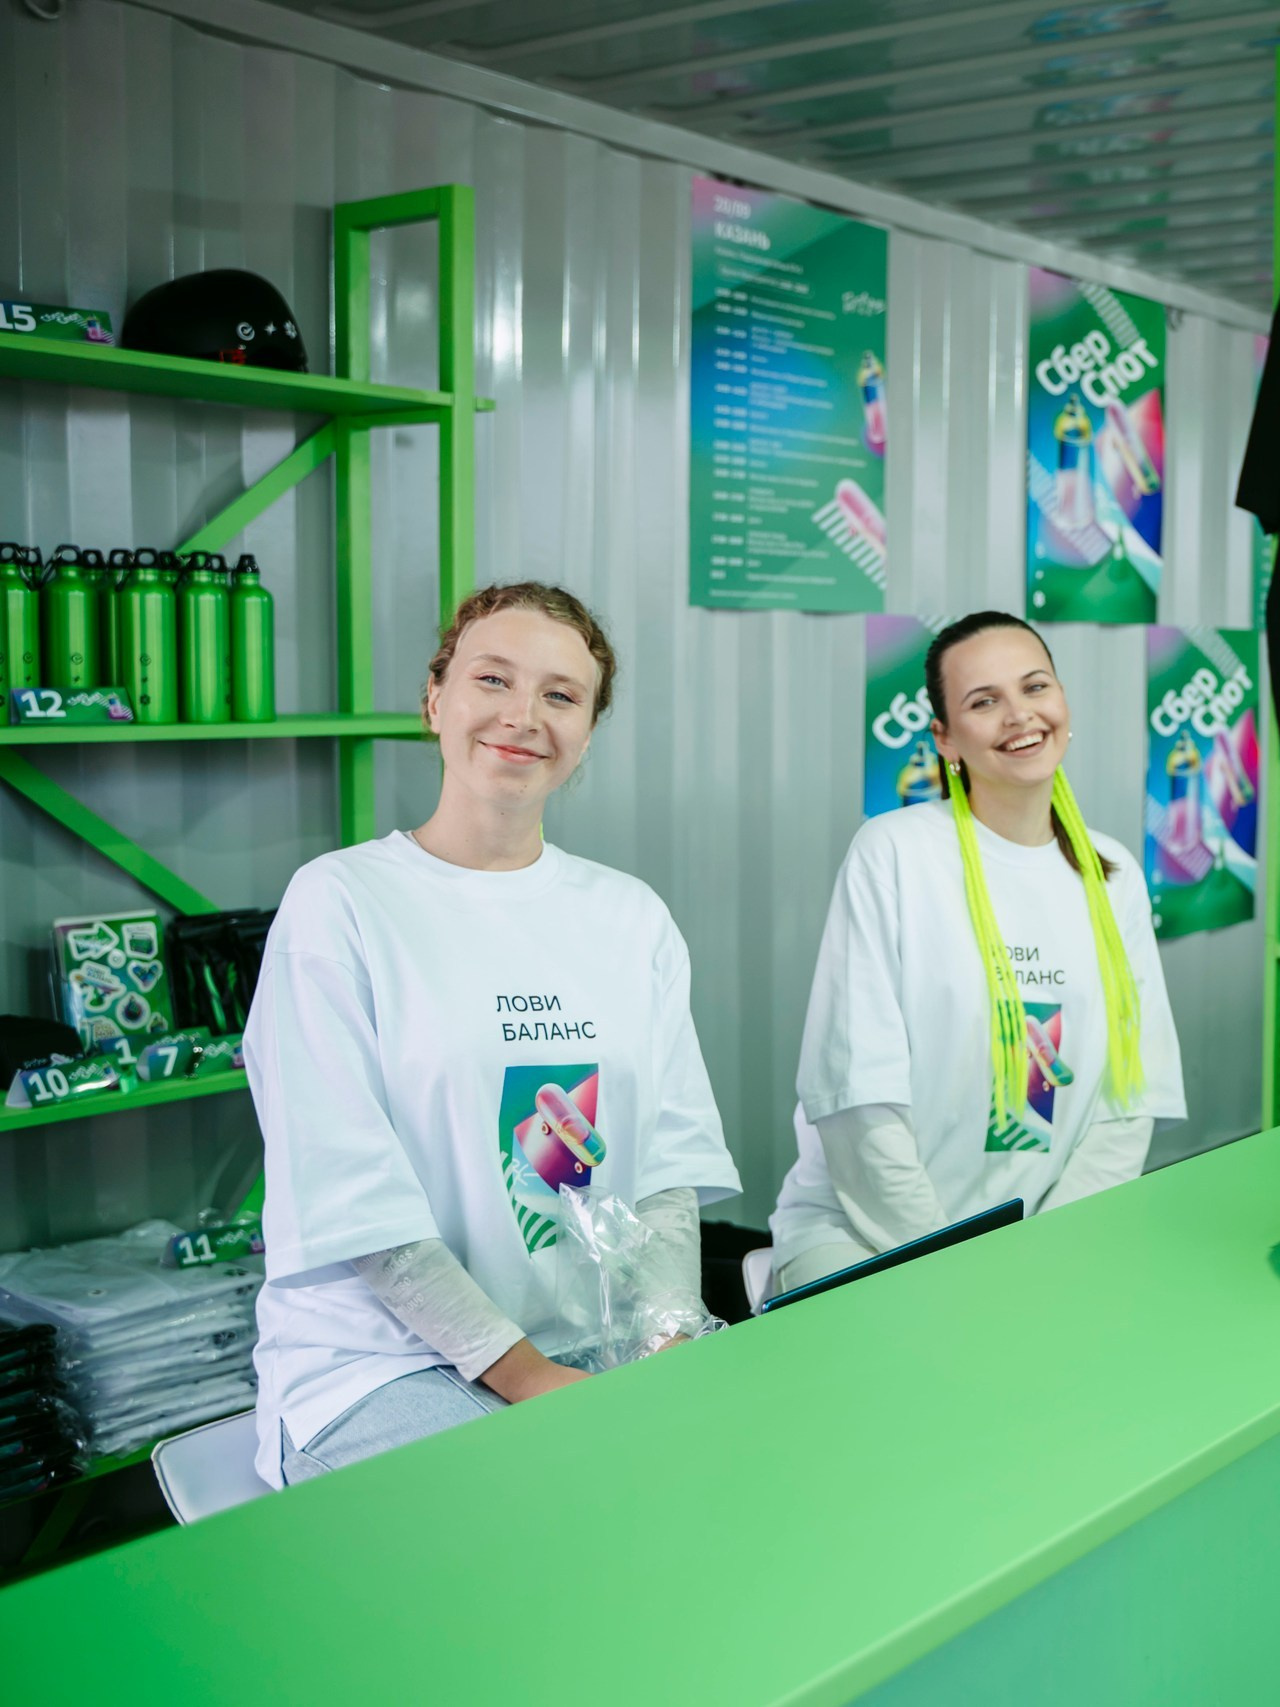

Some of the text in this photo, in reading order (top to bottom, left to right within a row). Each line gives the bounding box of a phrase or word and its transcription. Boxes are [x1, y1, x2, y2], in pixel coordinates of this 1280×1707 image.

[1035, 329, 1111, 396] Сбер
[1080, 338, 1158, 408] Спот
[21, 690, 67, 718] 12
[1150, 667, 1219, 738] Сбер
[1190, 664, 1253, 738] Спот
[1004, 945, 1040, 961] ОВИ
[496, 994, 562, 1013] ЛОВИ
[501, 1021, 597, 1042] БАЛАНС
[157, 1046, 178, 1077] 7
[28, 1068, 70, 1101] 10
[179, 1234, 216, 1265] 11
